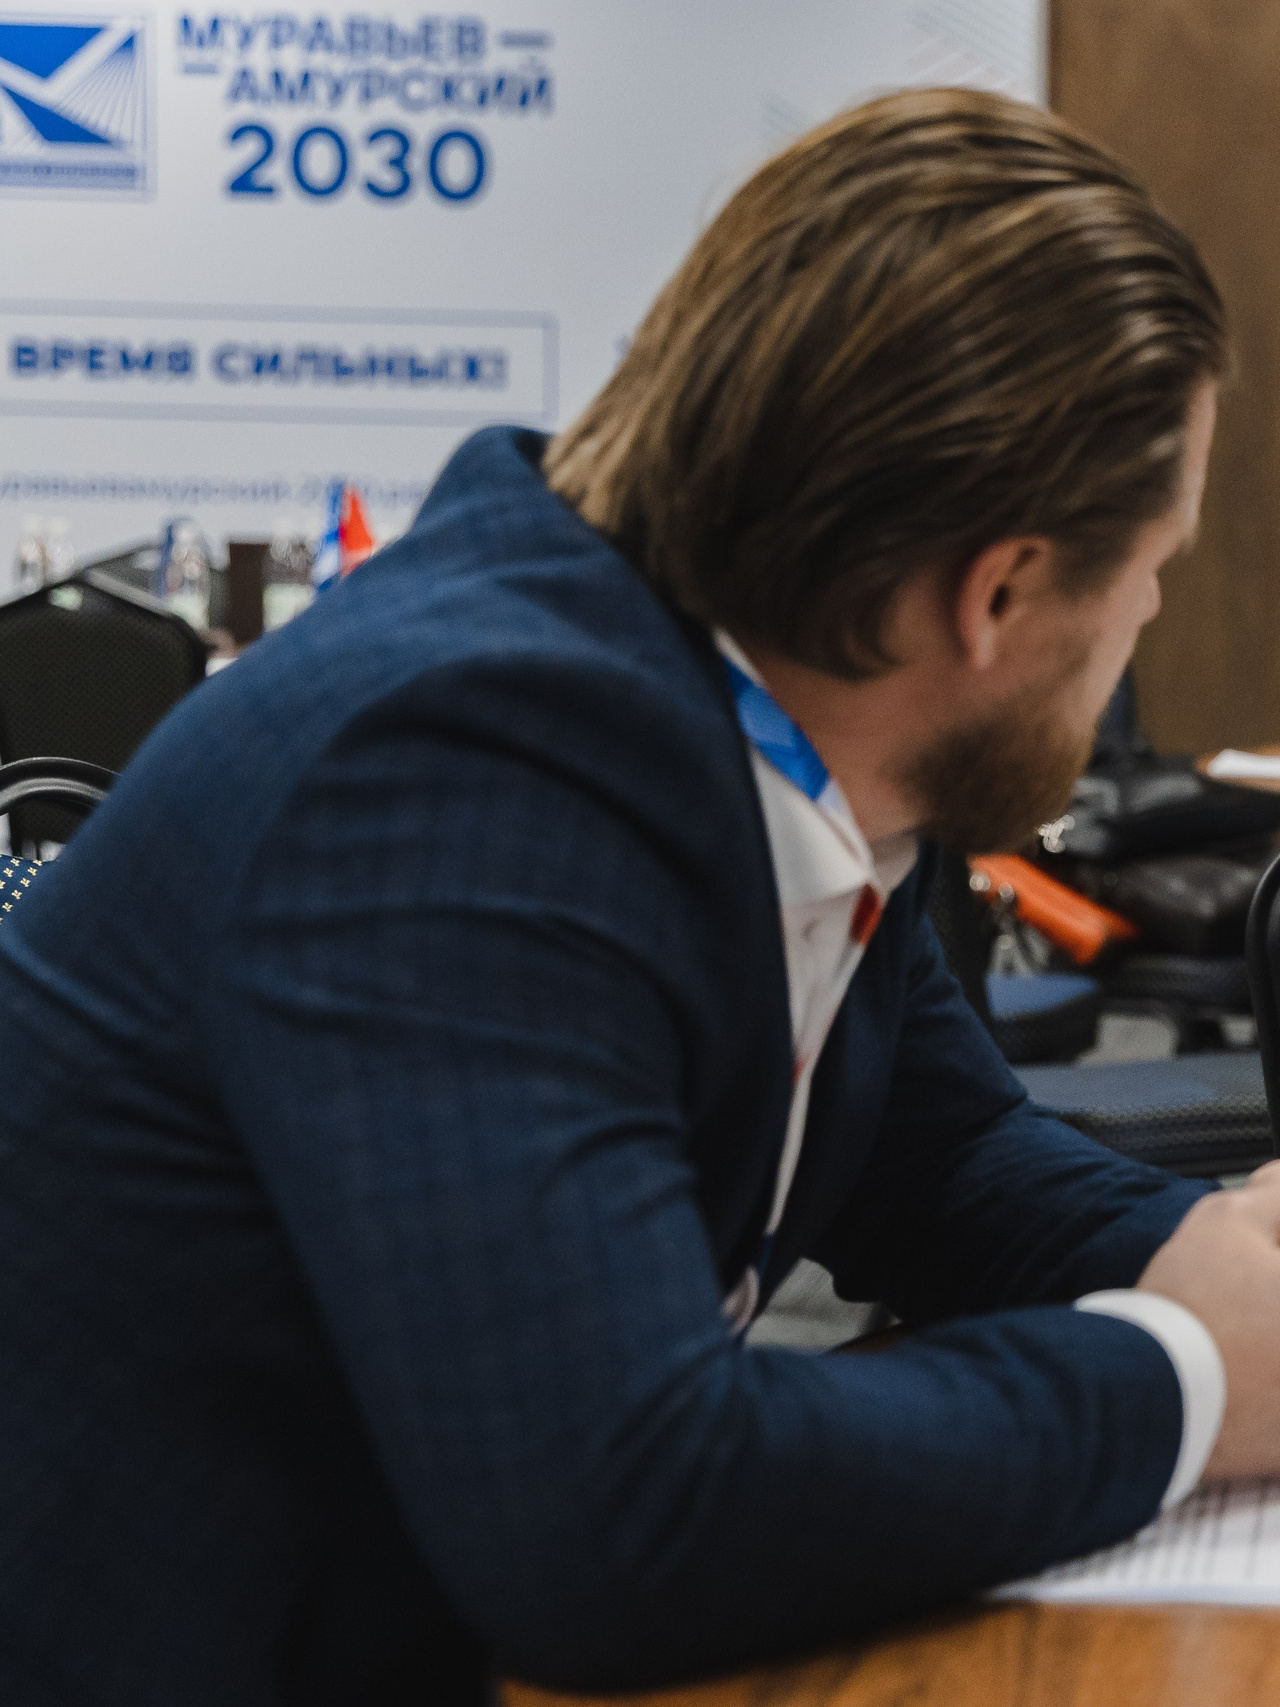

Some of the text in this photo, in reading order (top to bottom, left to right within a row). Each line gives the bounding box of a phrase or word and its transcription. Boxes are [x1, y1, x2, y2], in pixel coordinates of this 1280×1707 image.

[176, 12, 486, 63] МУРАВЬЕВ
[225, 57, 554, 115] АМУРСКИЙ
[226, 121, 487, 202] 2030
[9, 340, 509, 388] ВРЕМЯ СИЛЬНЫХ!
